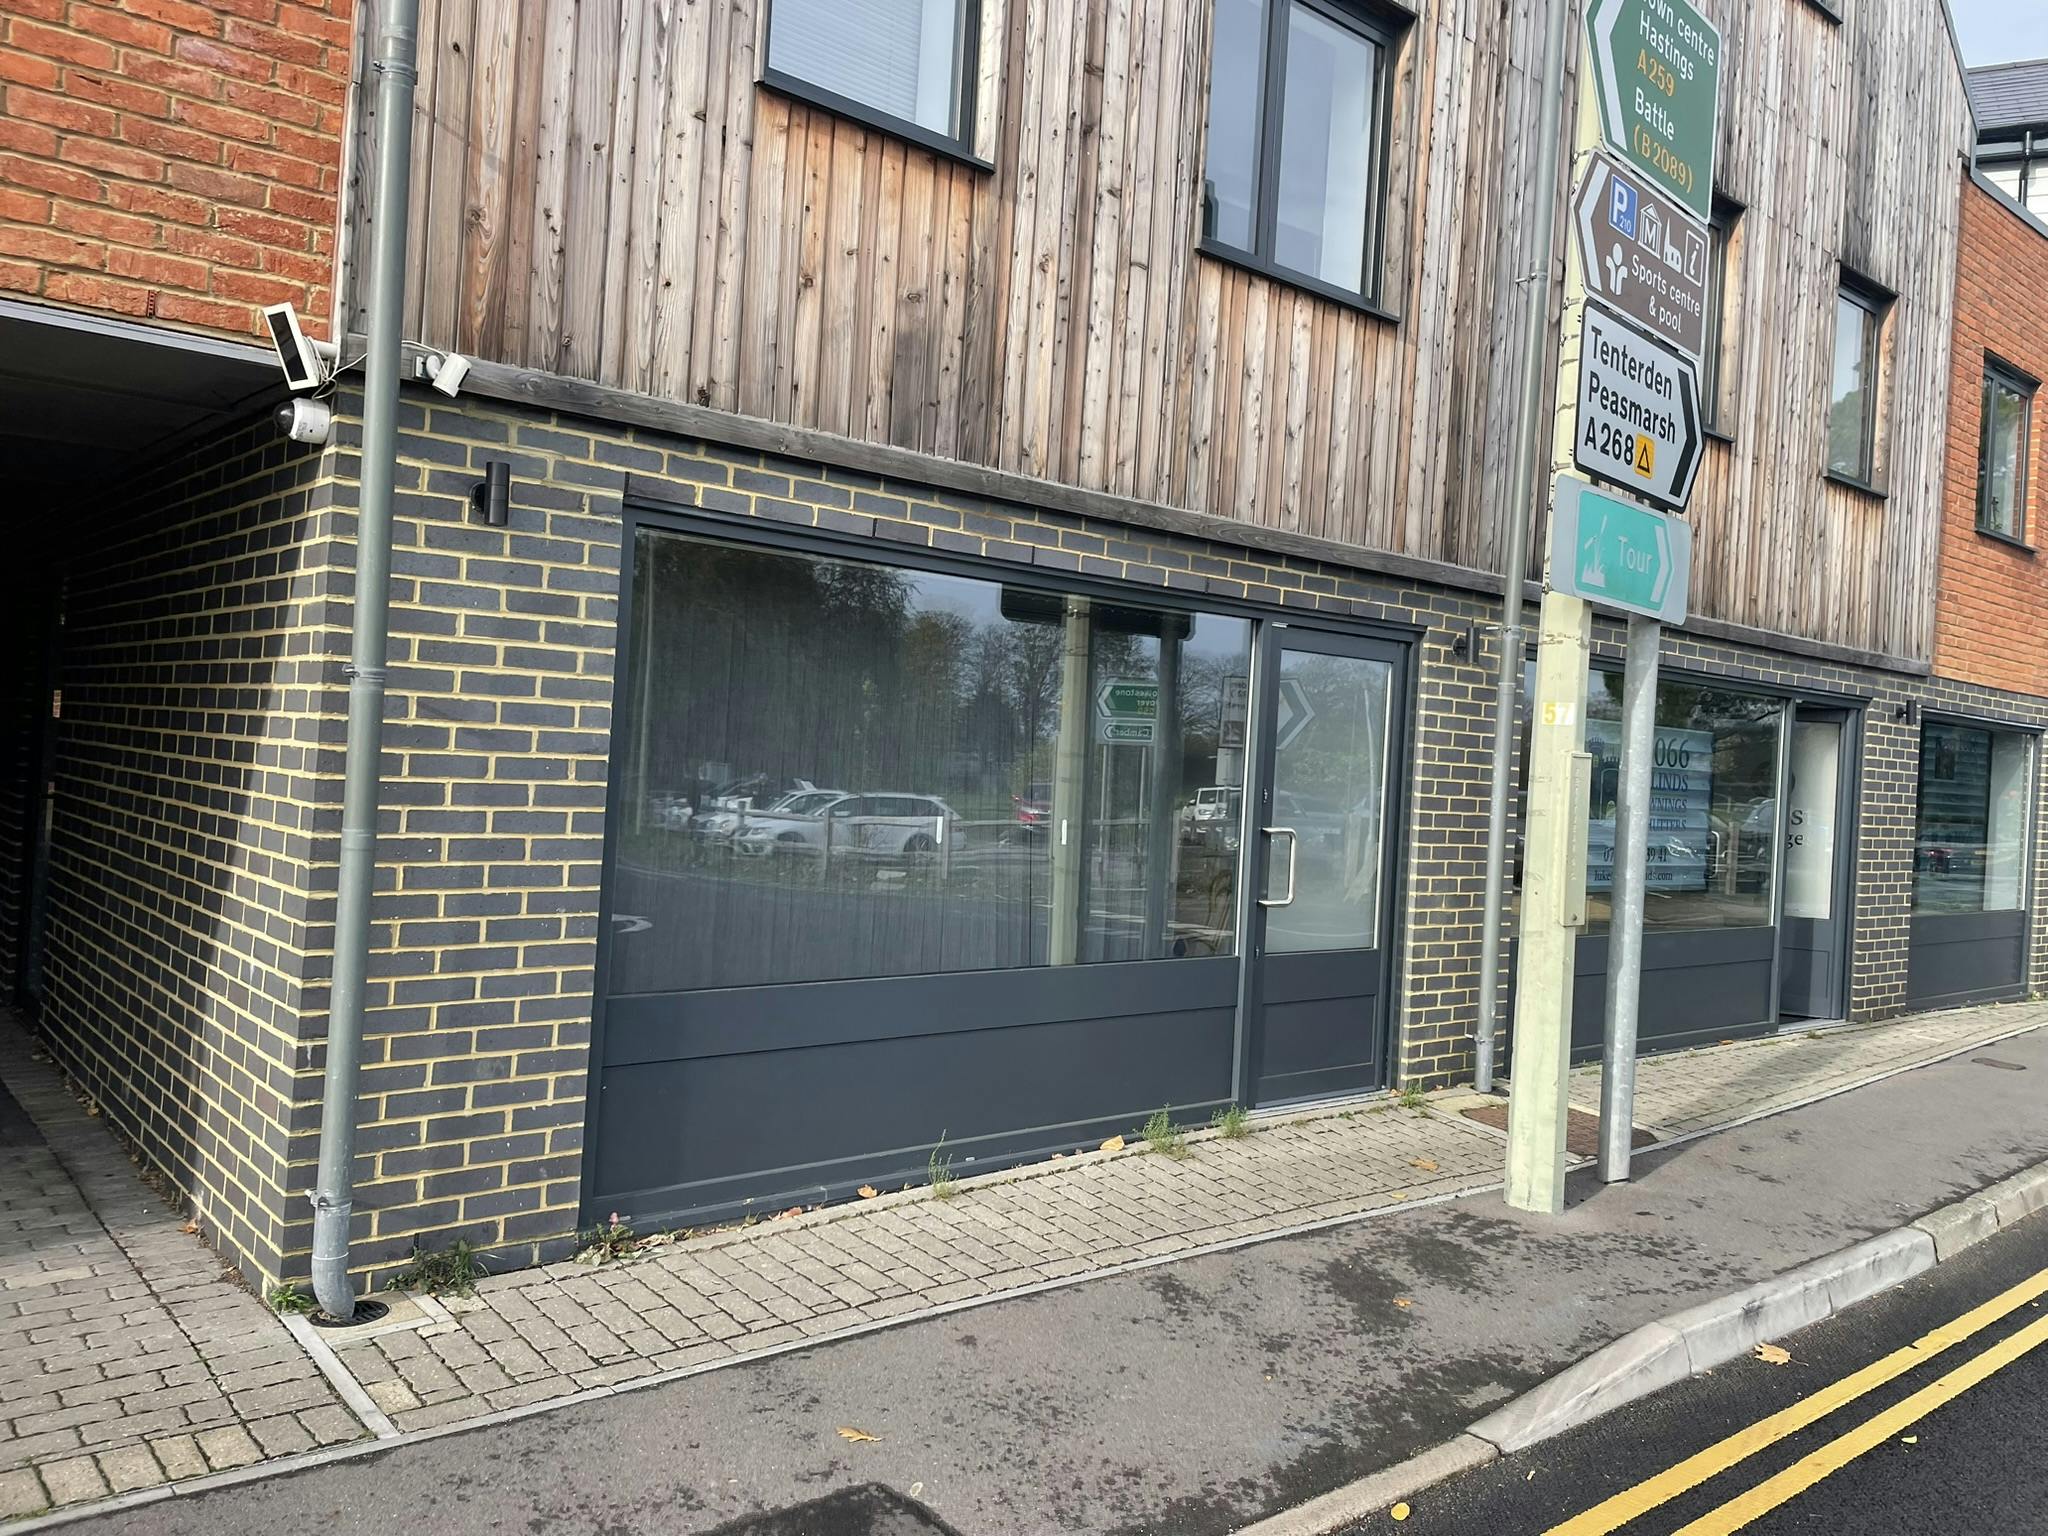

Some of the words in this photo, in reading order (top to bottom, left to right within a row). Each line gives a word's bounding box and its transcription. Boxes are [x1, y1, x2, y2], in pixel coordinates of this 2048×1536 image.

[1639, 9, 1694, 80] Hastings
[1643, 0, 1674, 28] own
[1677, 17, 1715, 66] centre
[1634, 86, 1675, 141] Battle
[1611, 182, 1628, 224] P
[1631, 253, 1667, 296] Sports
[1669, 285, 1701, 317] centre
[1648, 295, 1657, 317] &
[1658, 305, 1682, 334] pool
[1591, 325, 1673, 400] Tenterden
[1588, 370, 1676, 445] Peasmarsh
[1618, 535, 1653, 575] Tour
[1544, 703, 1569, 724] 57
[1654, 737, 1690, 769] 066
[1651, 772, 1689, 792] LINDS
[1649, 818, 1687, 832] HUTTERS
[1650, 797, 1688, 813] WNINGS
